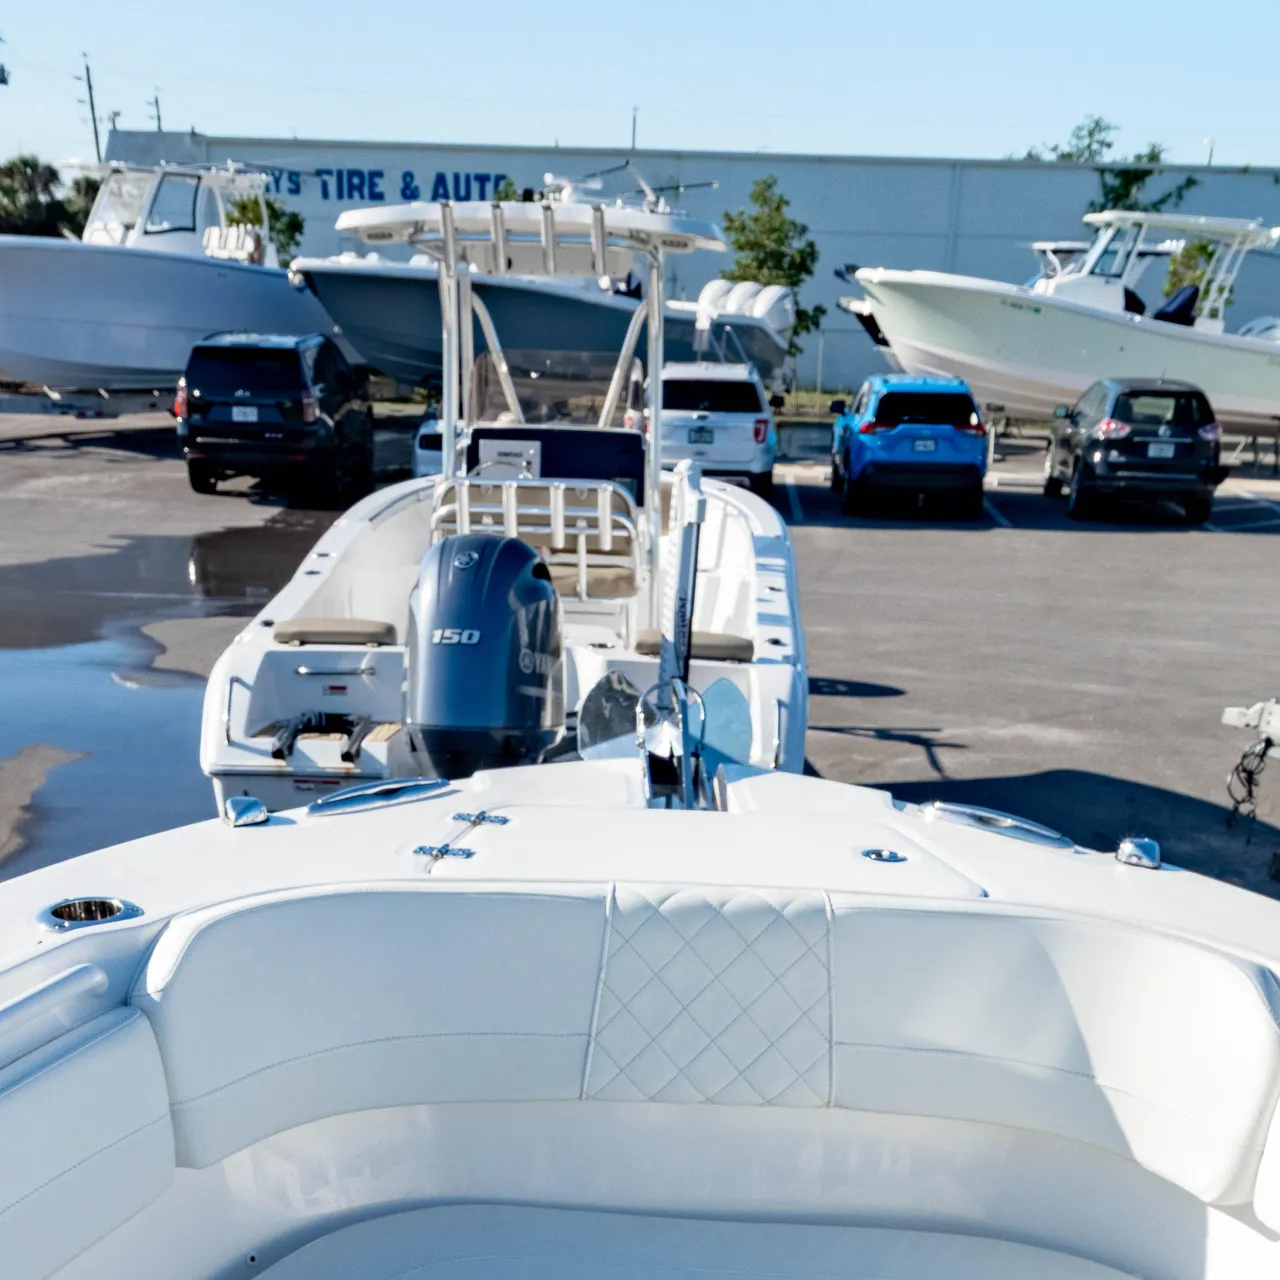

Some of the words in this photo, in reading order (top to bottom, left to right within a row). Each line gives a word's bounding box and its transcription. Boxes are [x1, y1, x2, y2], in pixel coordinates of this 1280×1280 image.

[314, 168, 385, 200] TIRE
[401, 170, 421, 201] &
[432, 628, 481, 645] 150
